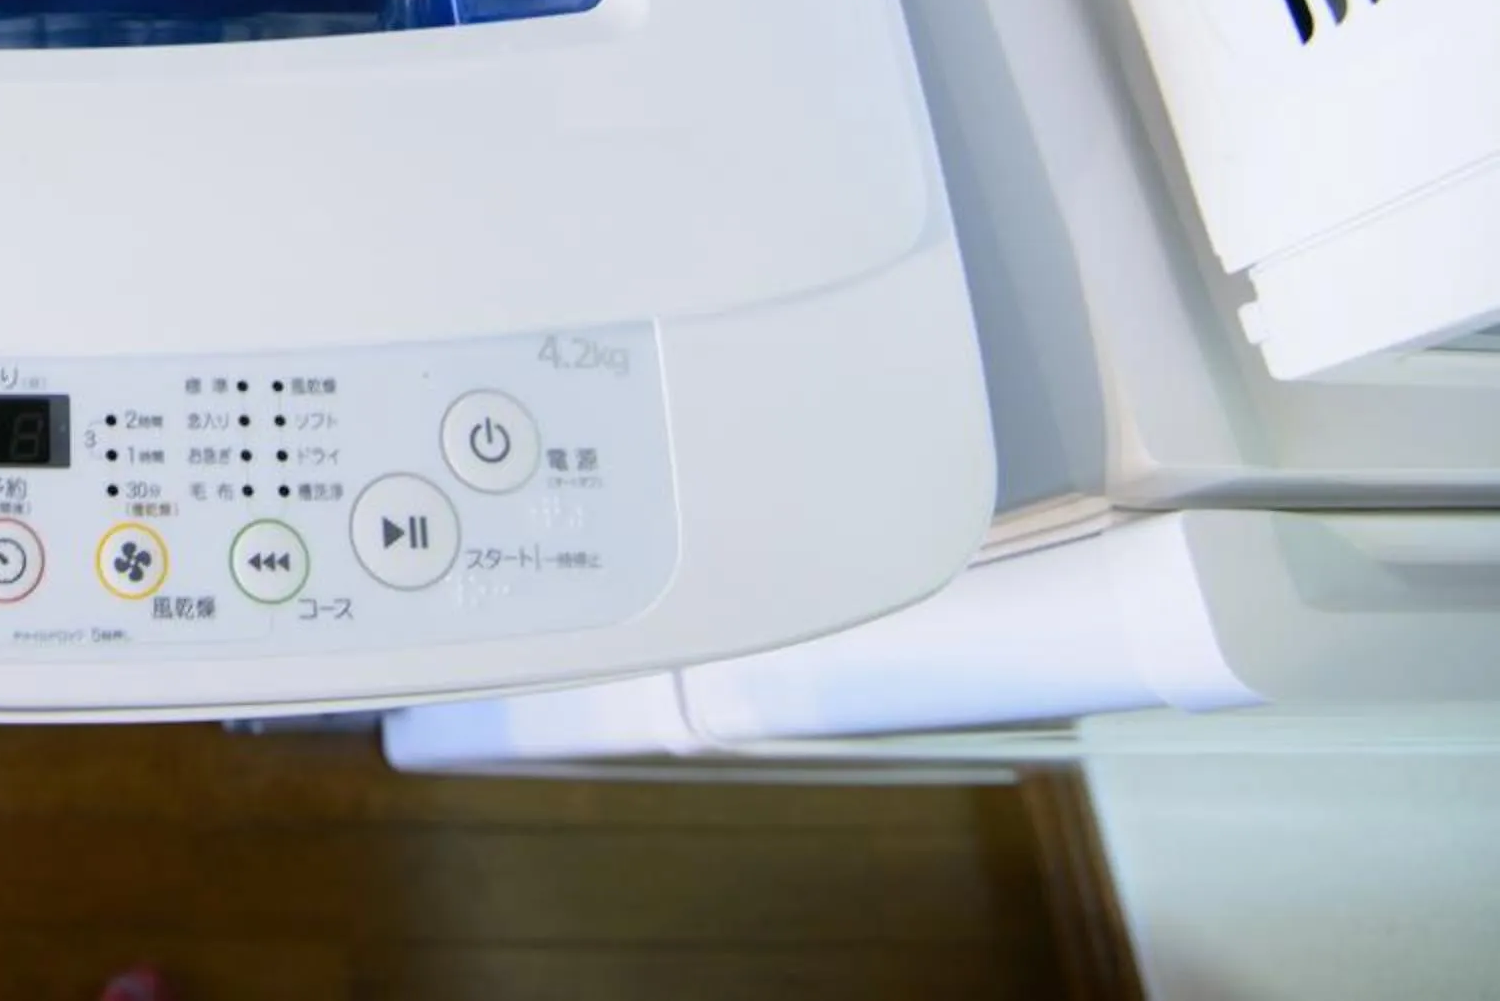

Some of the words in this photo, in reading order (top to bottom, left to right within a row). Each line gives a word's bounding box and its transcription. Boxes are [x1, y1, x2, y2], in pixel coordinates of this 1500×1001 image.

[537, 335, 630, 376] 4.2kg
[296, 412, 338, 431] ソフト
[297, 448, 341, 466] ドライ
[465, 544, 534, 570] スタート
[152, 595, 217, 621] 風乾燥
[298, 597, 355, 621] コース
